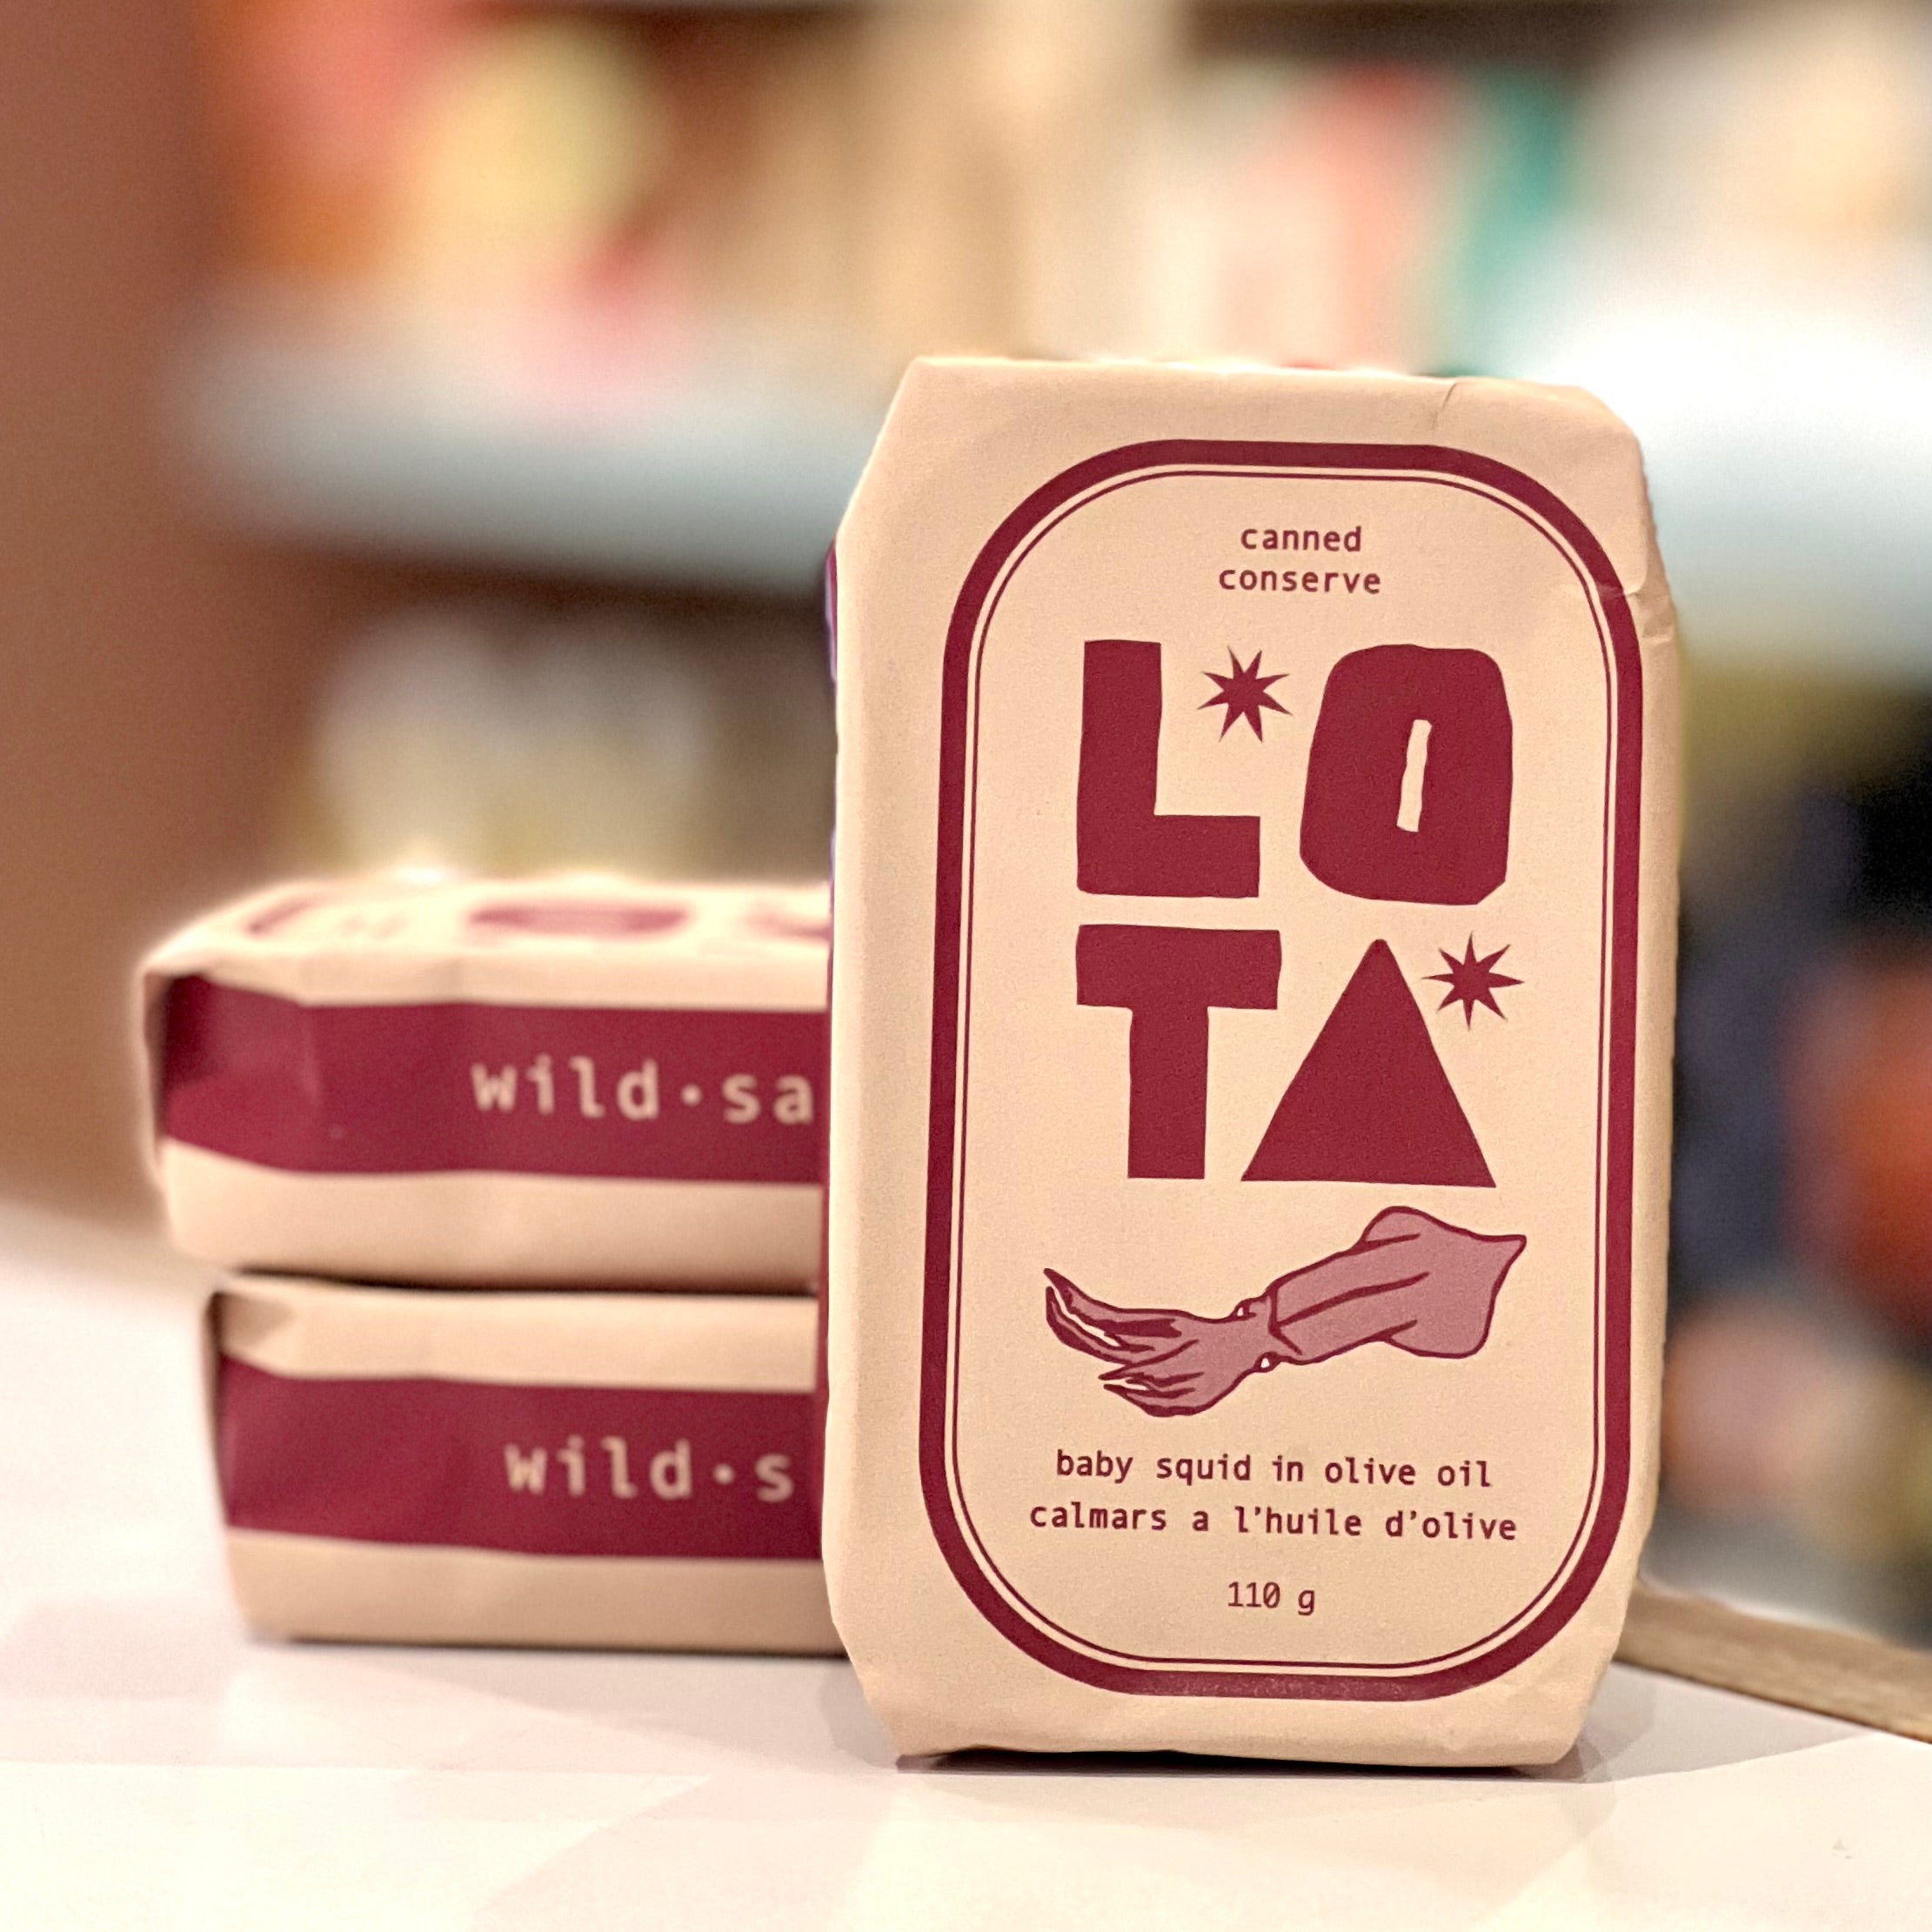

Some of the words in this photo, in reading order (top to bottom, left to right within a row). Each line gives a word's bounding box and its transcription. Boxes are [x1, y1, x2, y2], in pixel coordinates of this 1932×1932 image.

[1240, 525, 1362, 552] canned
[1219, 569, 1381, 595] conserve
[1056, 1448, 1133, 1484] baby
[1156, 1454, 1251, 1487] squid
[1272, 1454, 1304, 1482] in
[1324, 1456, 1416, 1486] olive
[1437, 1460, 1491, 1487] oil
[1030, 1501, 1167, 1531] calmars
[1192, 1510, 1209, 1532] a
[1234, 1505, 1362, 1537] l’huile
[1385, 1509, 1517, 1541] d’olive
[1227, 1581, 1281, 1609] 110
[1297, 1589, 1315, 1616] g
